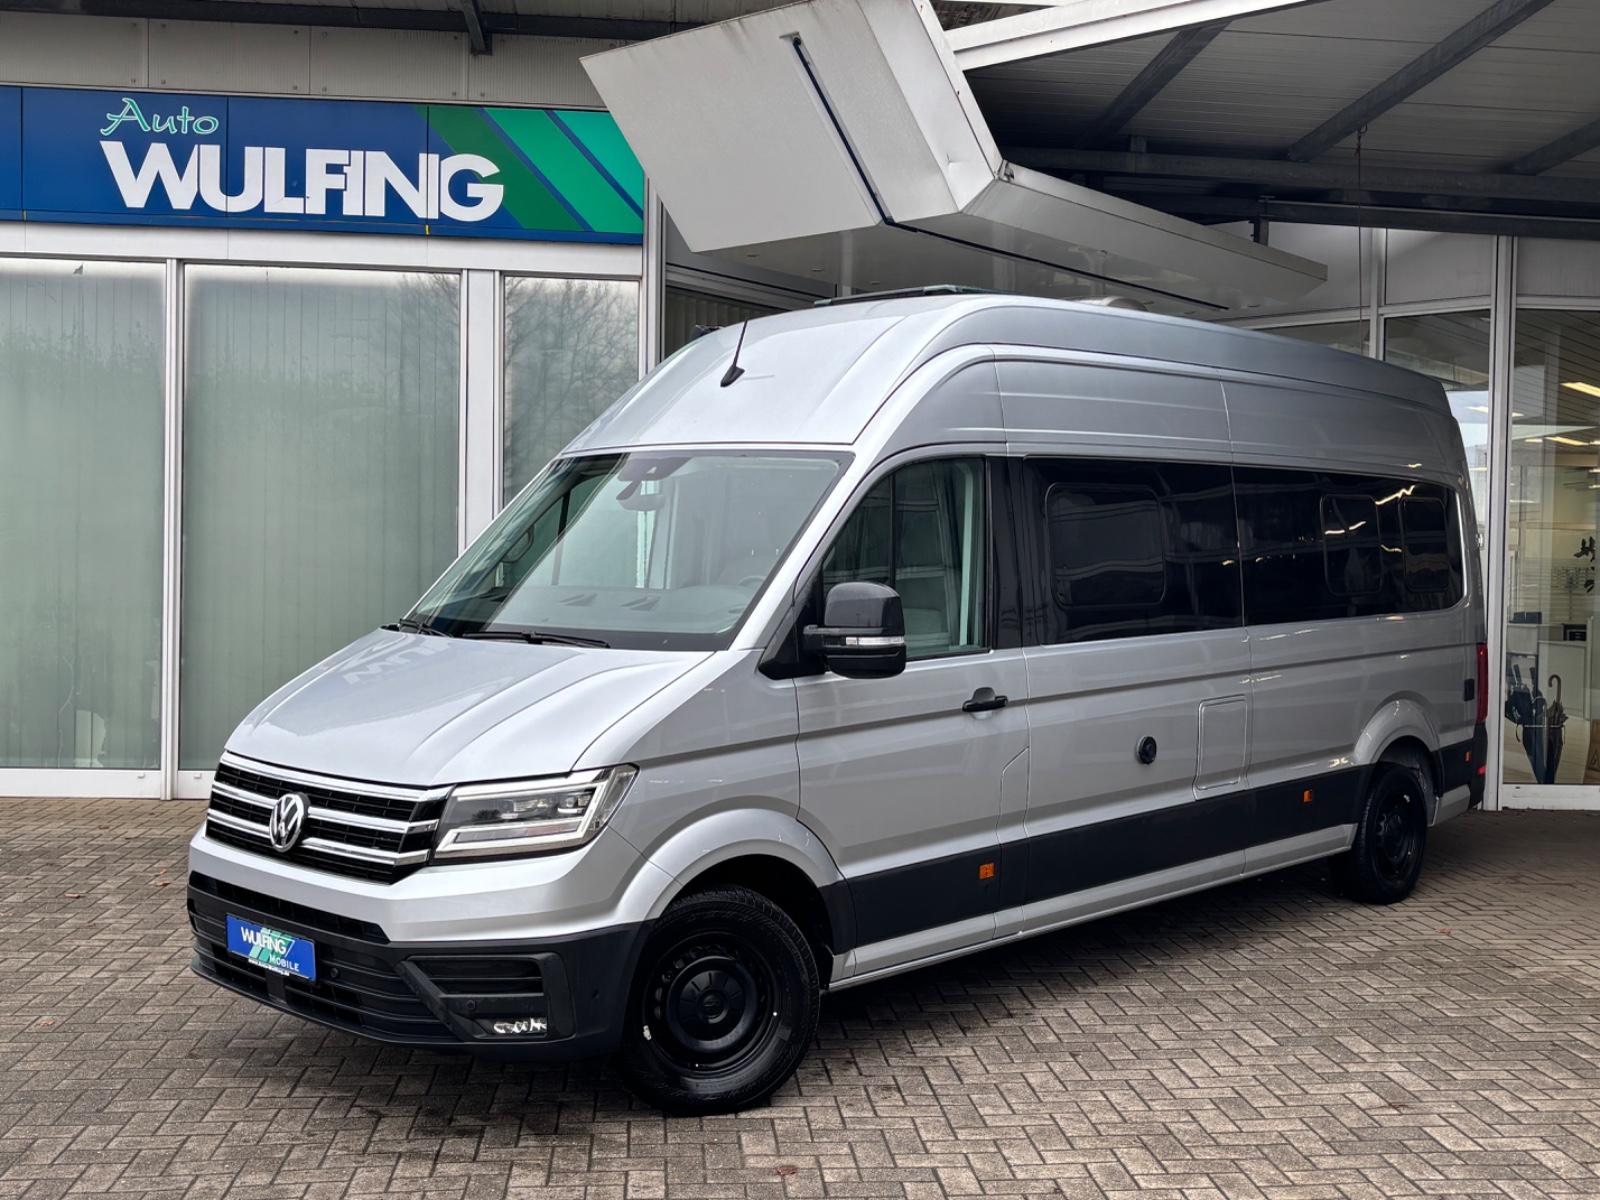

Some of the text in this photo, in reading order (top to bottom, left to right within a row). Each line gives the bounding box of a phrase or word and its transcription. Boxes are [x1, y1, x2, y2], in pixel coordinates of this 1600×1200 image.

[100, 97, 219, 136] Auto
[100, 140, 504, 222] WULFING
[241, 926, 287, 954] WULFING
